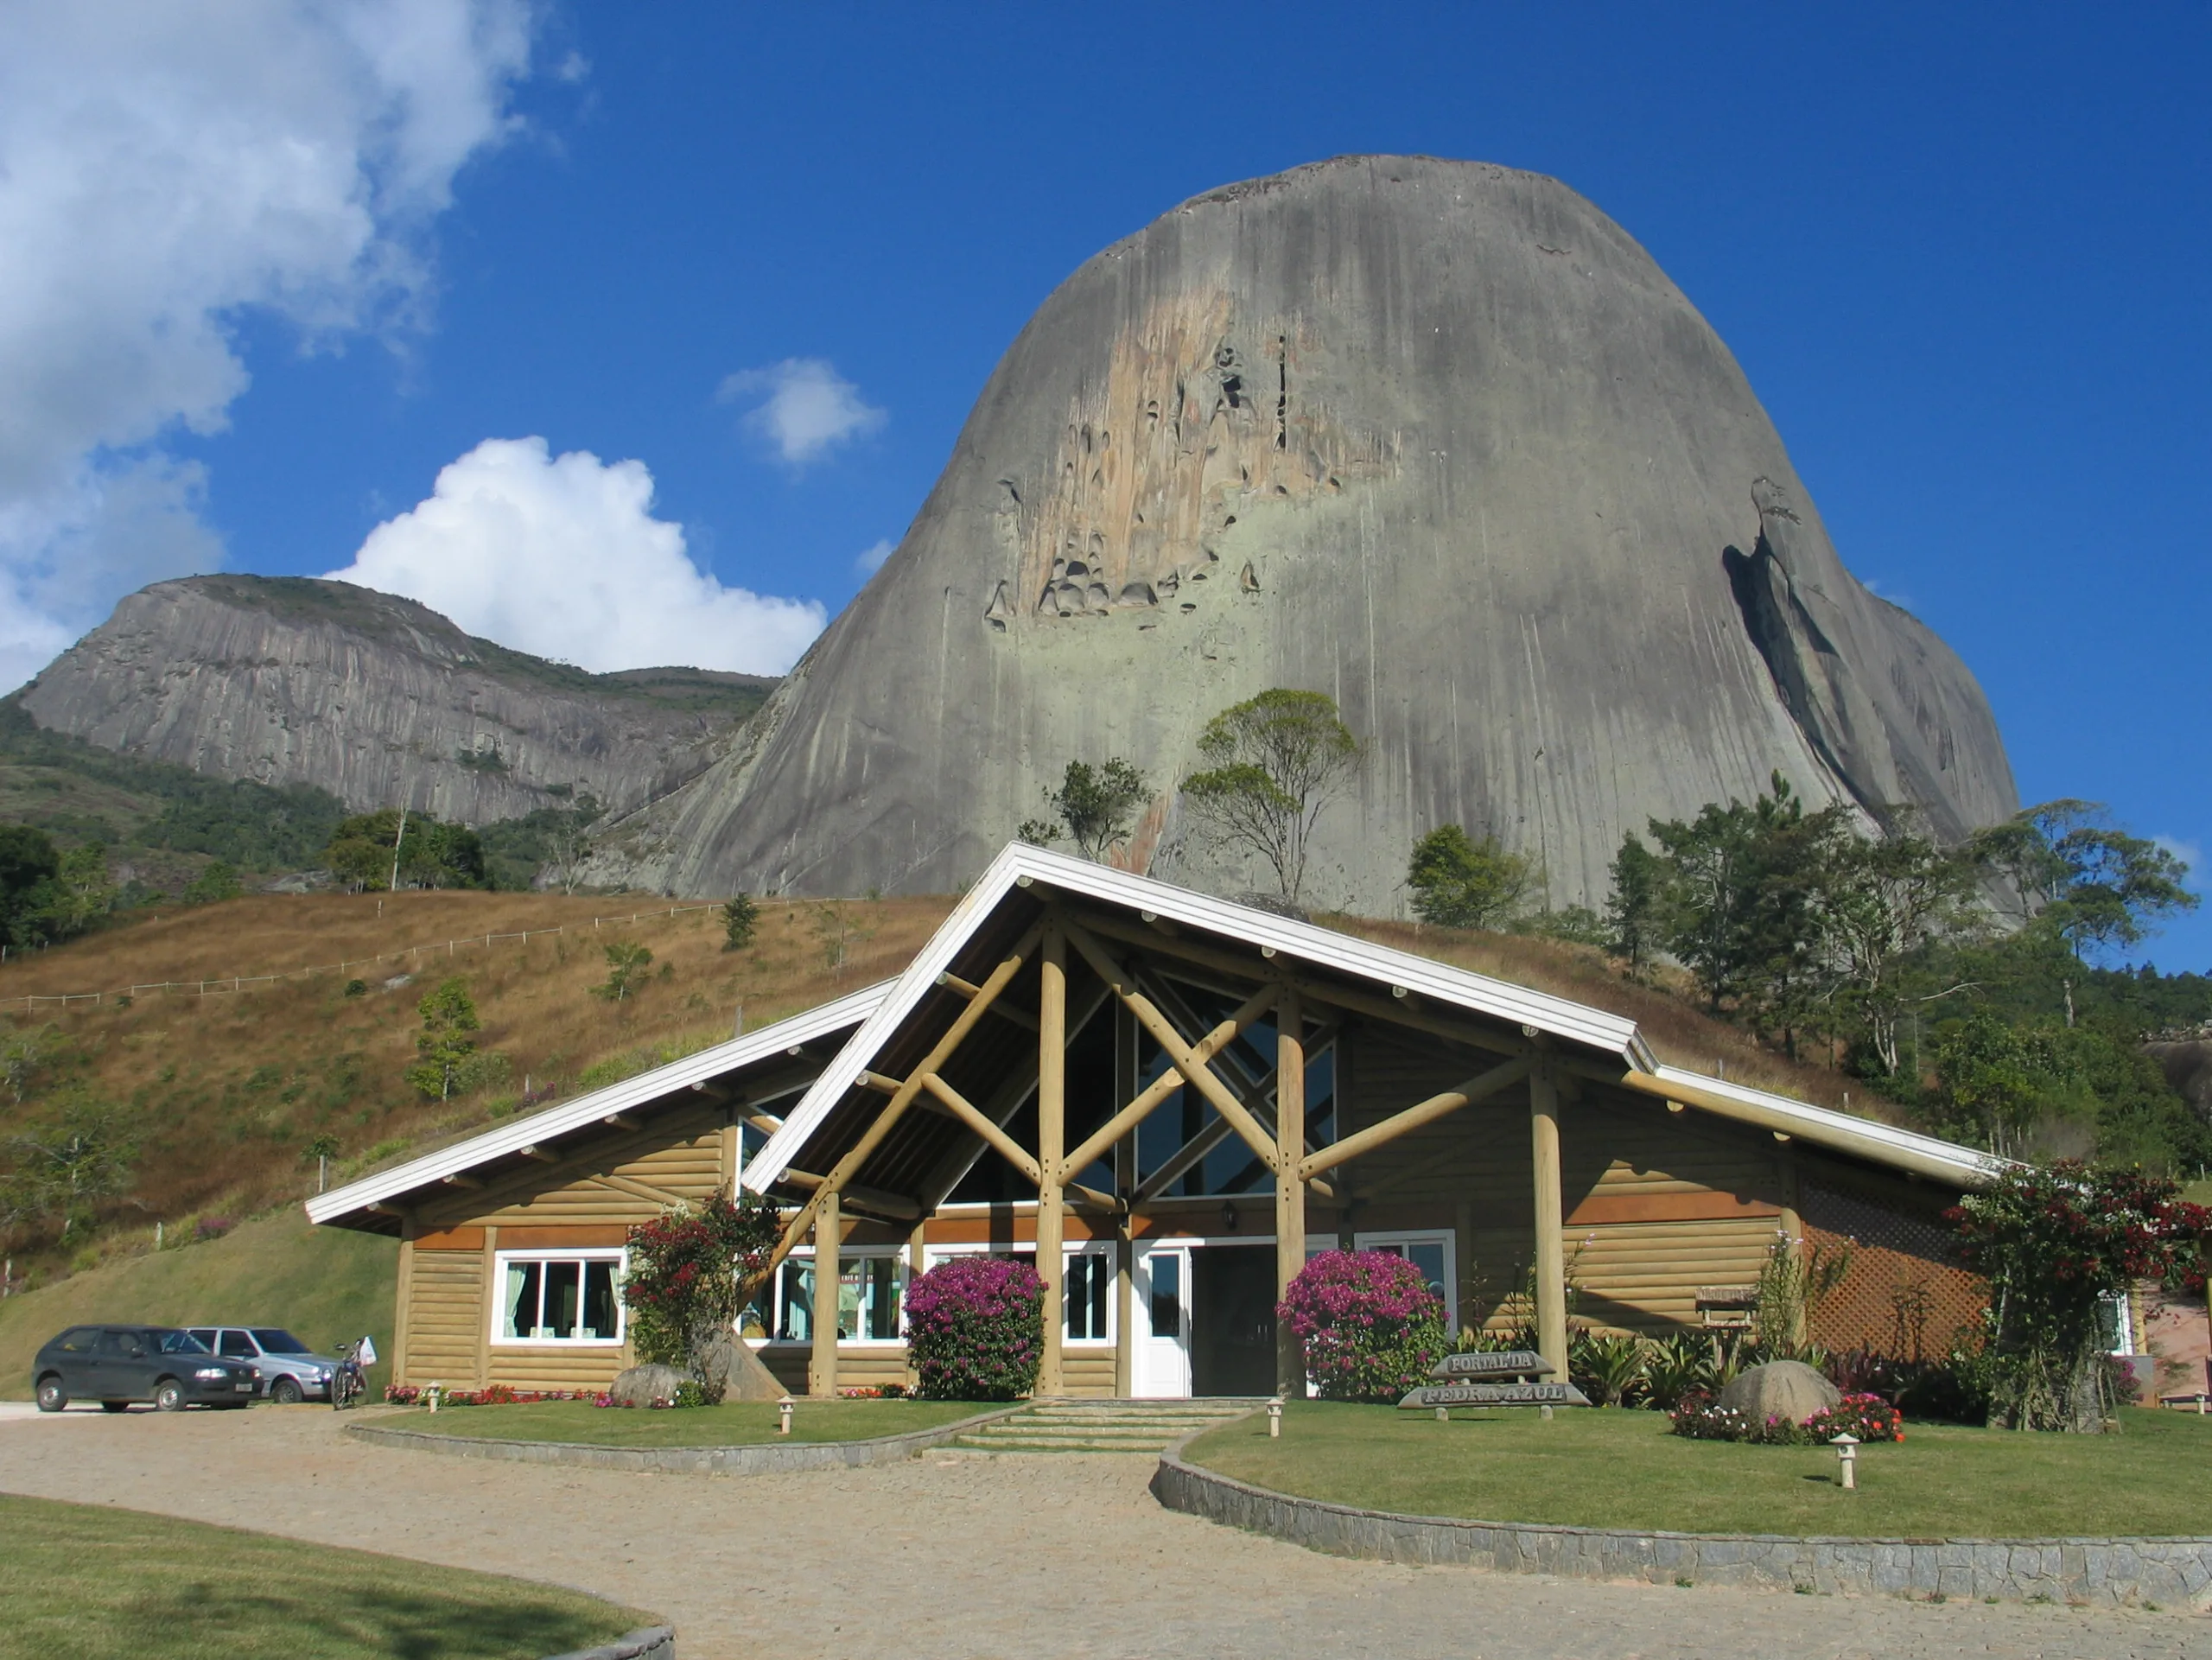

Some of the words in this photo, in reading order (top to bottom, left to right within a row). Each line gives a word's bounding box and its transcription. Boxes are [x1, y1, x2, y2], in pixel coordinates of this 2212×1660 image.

[1452, 1356, 1509, 1371] PORTAL
[1511, 1353, 1533, 1368] DA
[1425, 1387, 1500, 1402] PEDRA
[1504, 1385, 1563, 1401] AZUL
